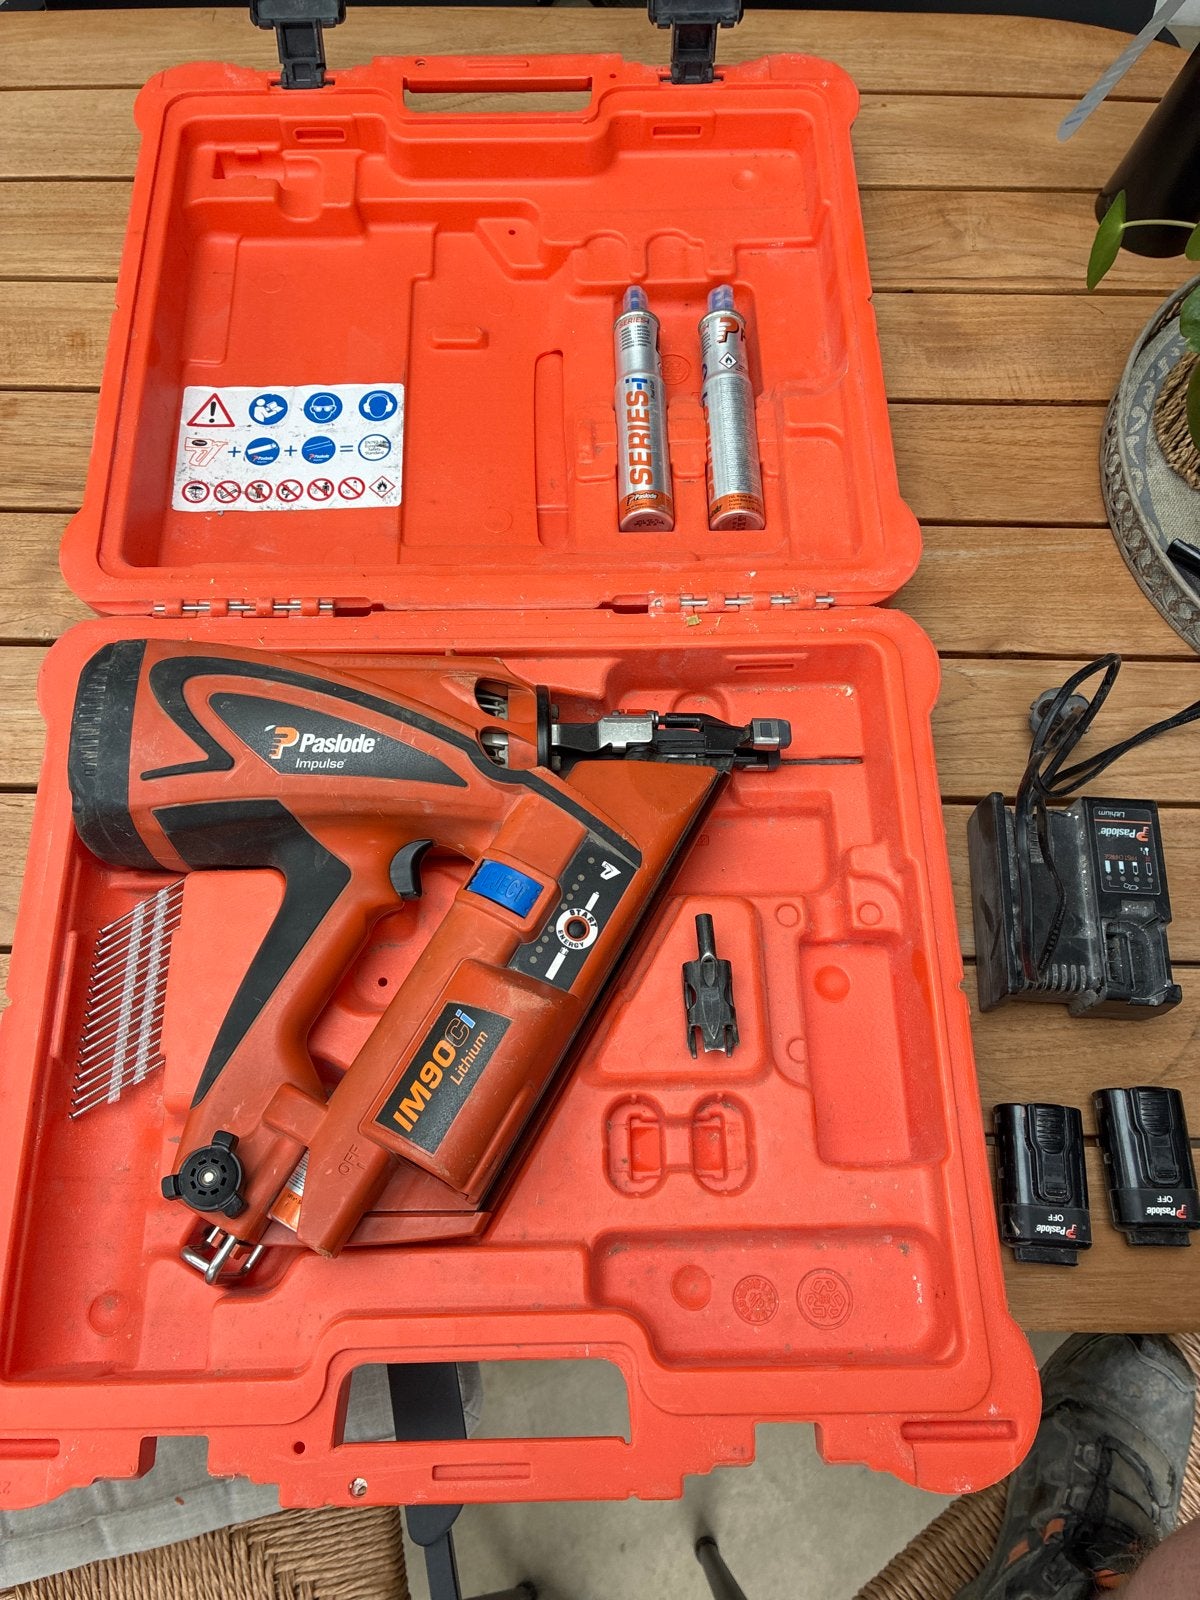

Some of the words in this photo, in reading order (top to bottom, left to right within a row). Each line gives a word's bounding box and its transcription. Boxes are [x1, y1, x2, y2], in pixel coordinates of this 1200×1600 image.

[625, 377, 653, 486] SERIES-i
[299, 733, 376, 754] Paslode
[295, 758, 345, 772] Impulse
[1098, 810, 1126, 818] Lithium
[1100, 827, 1136, 839] Paslode
[569, 909, 598, 928] START
[557, 929, 585, 949] ENERGY
[450, 1031, 489, 1086] Lithium
[1157, 1195, 1173, 1203] OFF
[1047, 1214, 1064, 1222] OFF
[1146, 1206, 1176, 1217] Paslode
[1036, 1224, 1066, 1236] Paslode
